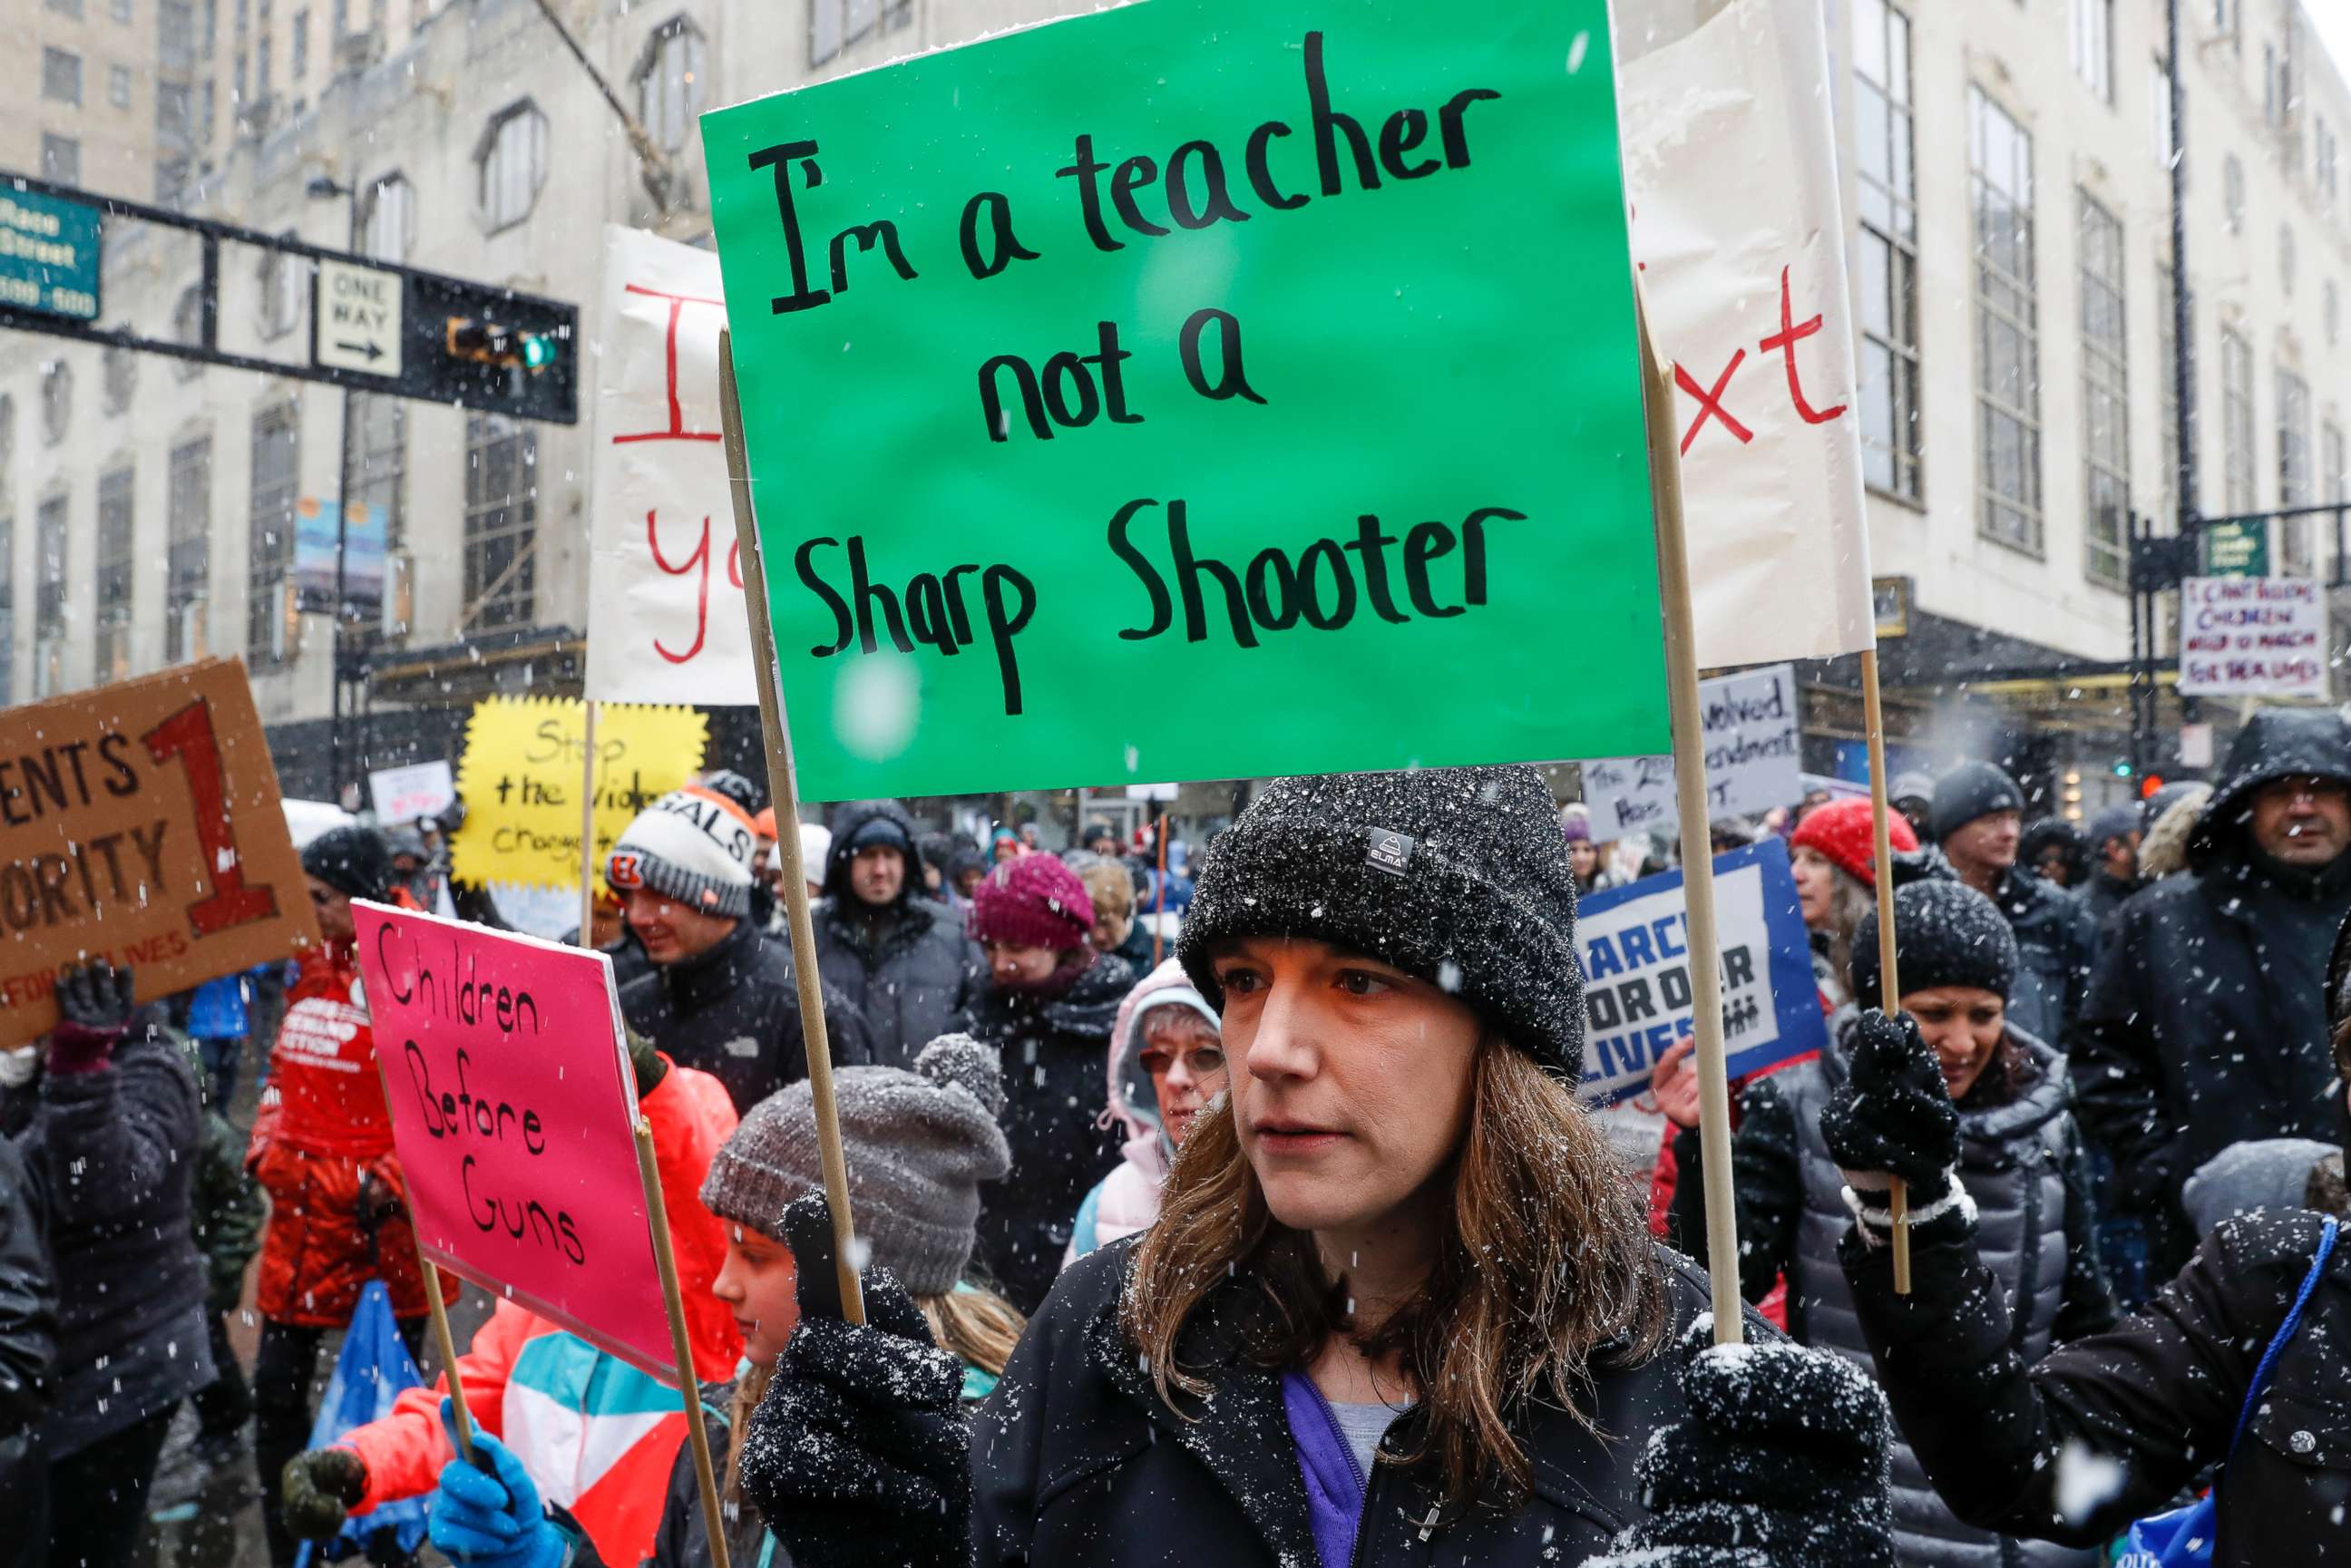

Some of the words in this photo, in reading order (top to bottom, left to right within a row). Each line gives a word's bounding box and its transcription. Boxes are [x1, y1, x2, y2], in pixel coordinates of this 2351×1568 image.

[748, 140, 919, 316] I'm
[960, 192, 1041, 280] a
[1056, 31, 1501, 252] teacher
[334, 272, 387, 305] ONE
[334, 303, 388, 330] WAY
[979, 321, 1145, 443] not
[1180, 308, 1268, 404] a
[794, 535, 1037, 716] Sharp
[1107, 499, 1527, 648] Shooter
[495, 774, 566, 806] the
[0, 819, 168, 938] ORITY
[379, 921, 538, 1035] Children
[1575, 912, 1685, 982] ARC
[1585, 977, 1658, 1032] OR
[1657, 945, 1755, 1011] OR
[405, 1039, 545, 1156] Before
[463, 1154, 585, 1266] Guns
